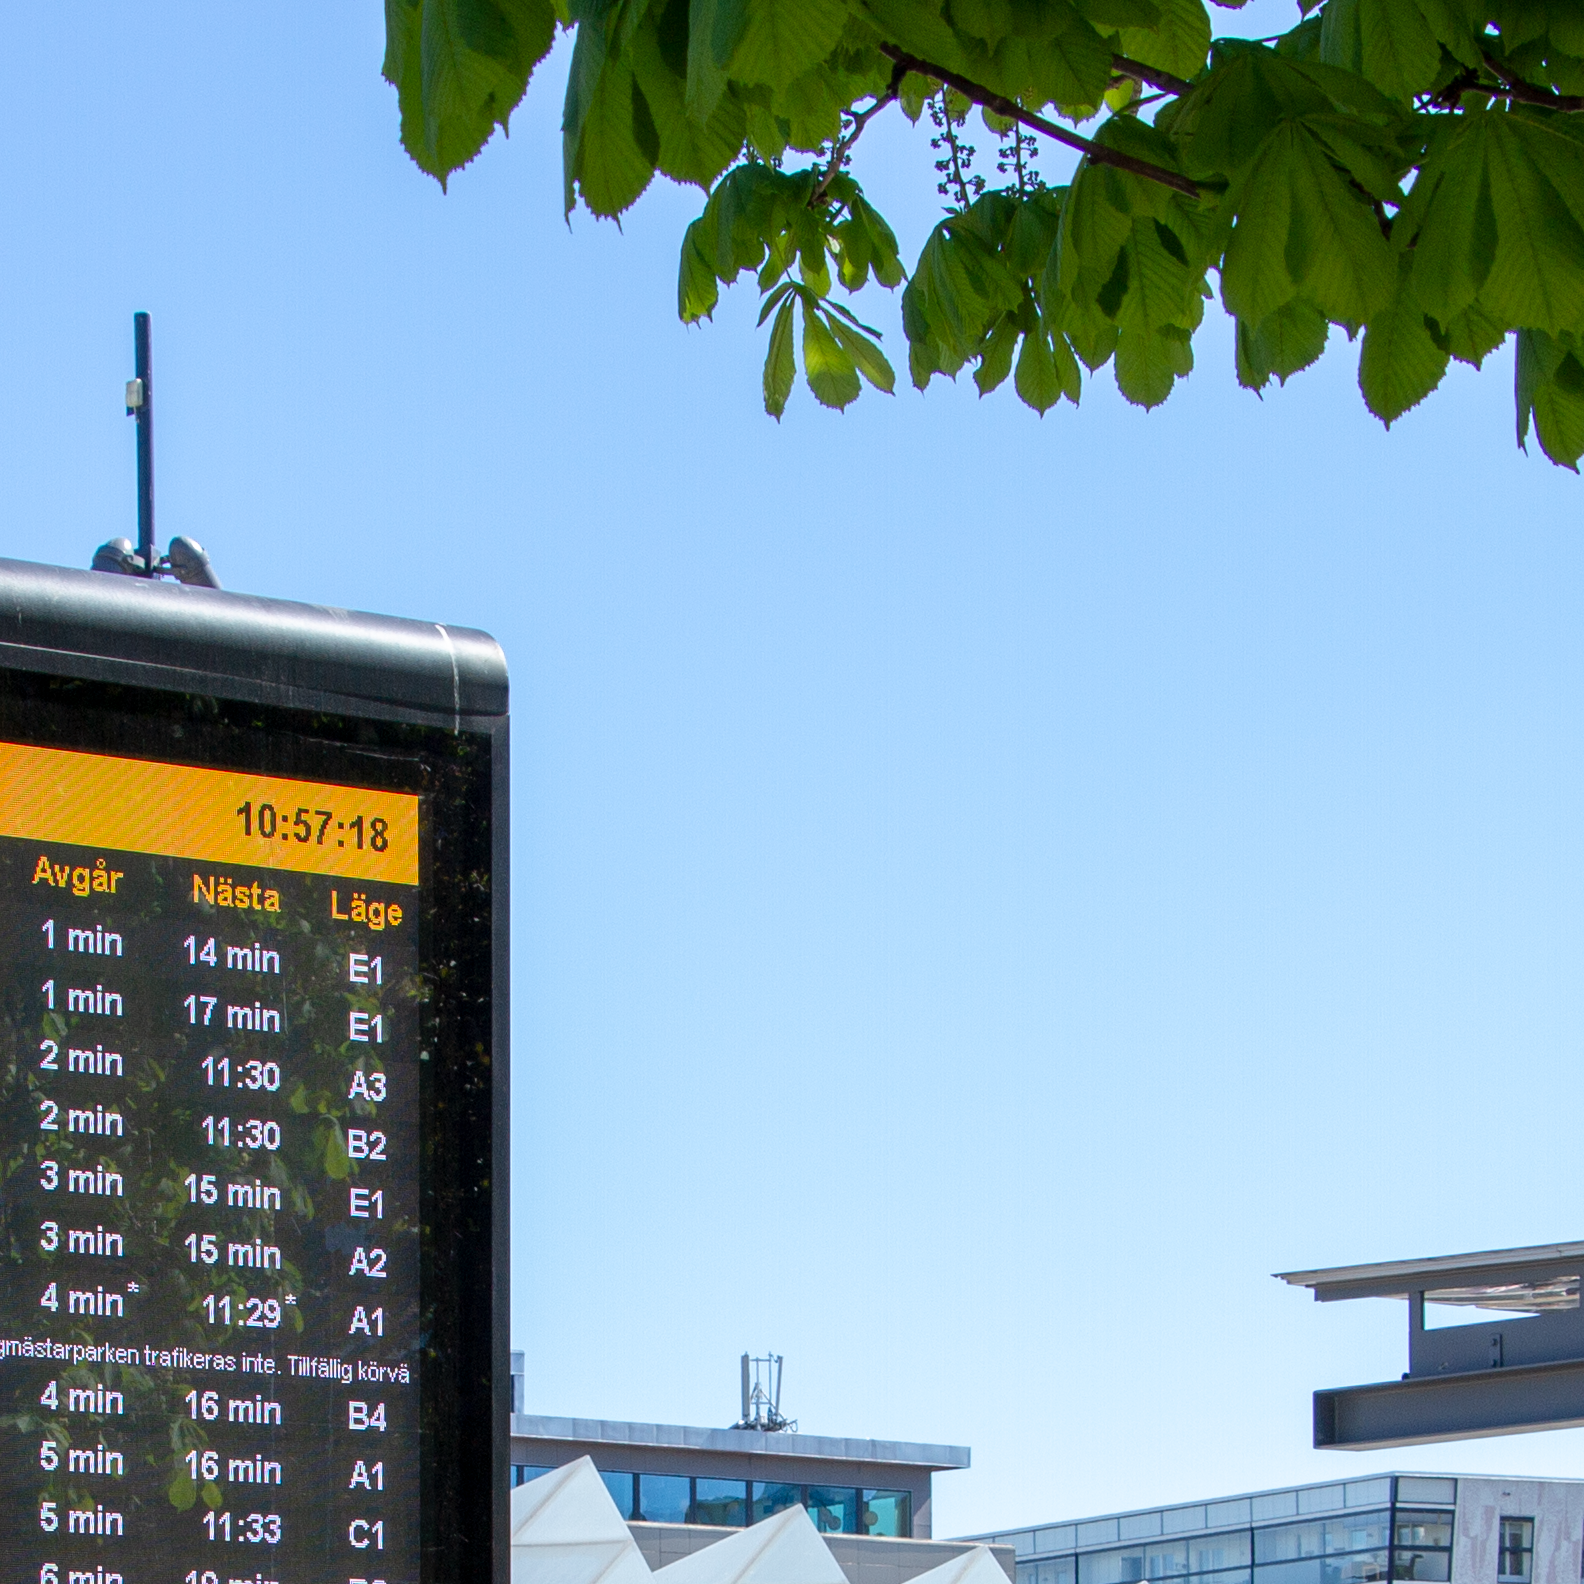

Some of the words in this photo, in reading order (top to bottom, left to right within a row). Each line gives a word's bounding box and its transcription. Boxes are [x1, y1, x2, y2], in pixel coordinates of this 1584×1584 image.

[236, 801, 389, 853] 10:57:18
[32, 855, 124, 897] Avgår
[193, 873, 281, 913] Nästa
[331, 890, 403, 930] Läge
[42, 919, 55, 948] 1
[68, 924, 123, 956] min
[184, 935, 216, 966] 14
[226, 943, 280, 974] min
[349, 953, 383, 985] E1
[184, 995, 216, 1025] 17
[226, 1003, 280, 1033] min
[349, 1012, 383, 1044] E1
[202, 1056, 281, 1092] 11:30
[348, 1070, 387, 1102] A3
[202, 1116, 281, 1151] 11:30
[348, 1129, 387, 1161] B2
[184, 1174, 217, 1204] 15
[227, 1180, 281, 1210] min
[349, 1188, 383, 1219] E1
[184, 1233, 217, 1264] 15
[227, 1239, 281, 1270] min
[348, 1247, 387, 1278] A2
[40, 1282, 58, 1311] 4
[349, 1306, 383, 1337] A1
[143, 1346, 237, 1373] trafikeras
[241, 1352, 282, 1375] inte.
[287, 1355, 353, 1384] Tillfällig
[358, 1359, 410, 1384] körvä
[40, 1380, 58, 1410] 4
[68, 1384, 124, 1414] min
[185, 1391, 219, 1420] 16
[227, 1395, 282, 1425] min
[348, 1401, 387, 1432] B4
[185, 1451, 219, 1480] 16
[227, 1455, 282, 1485] min
[349, 1460, 384, 1491] A1
[202, 1511, 282, 1543] 11:33
[349, 1519, 384, 1550] C1
